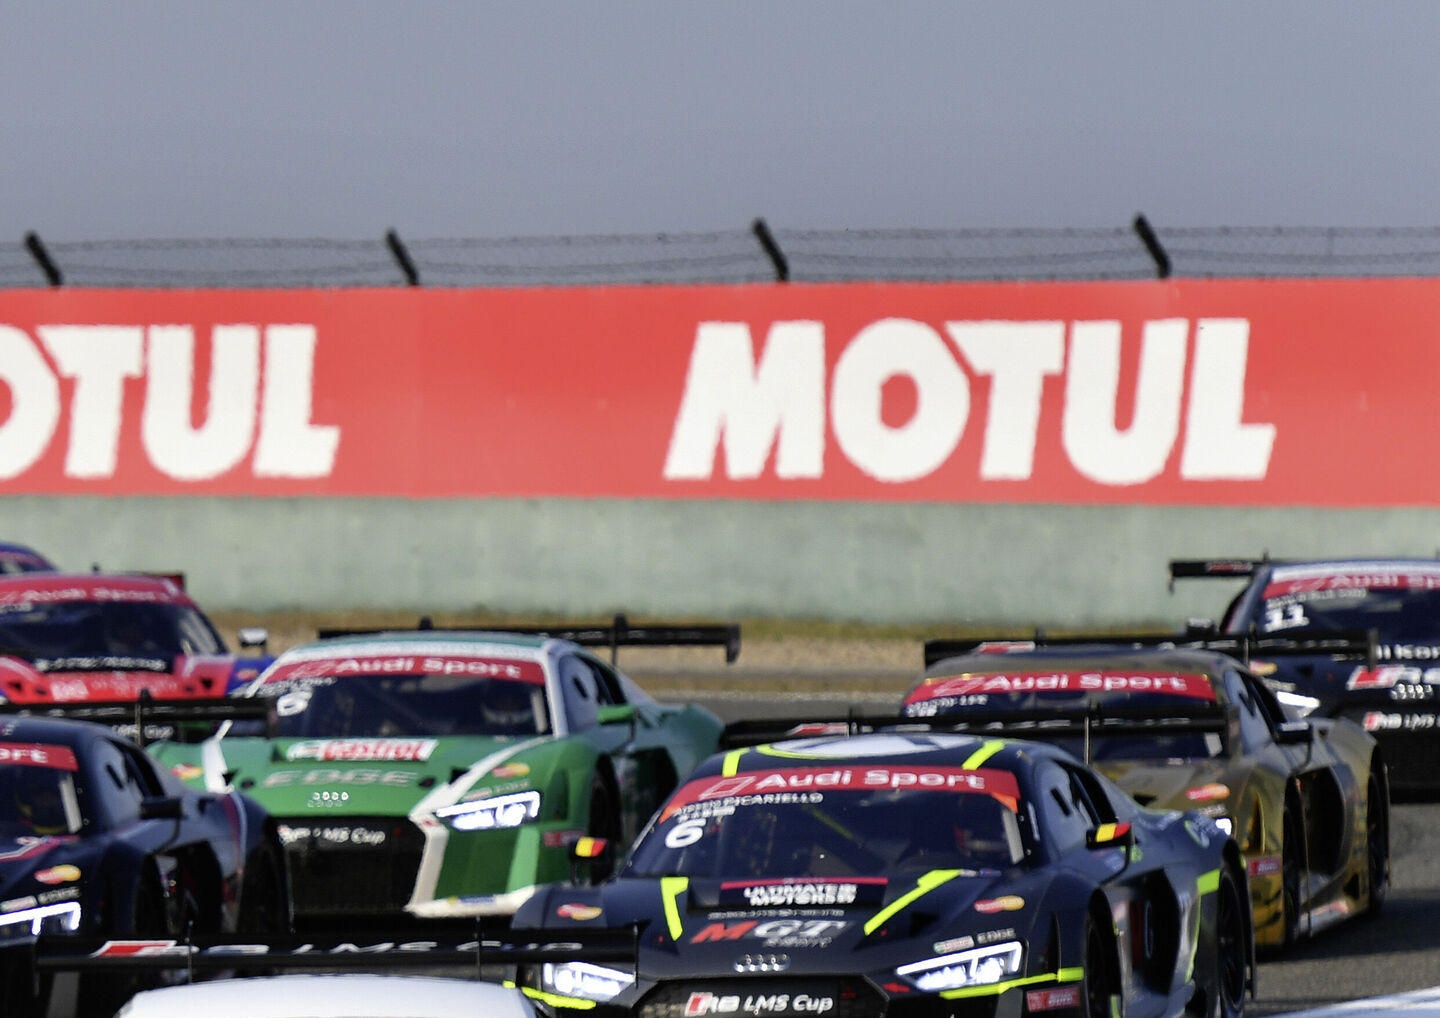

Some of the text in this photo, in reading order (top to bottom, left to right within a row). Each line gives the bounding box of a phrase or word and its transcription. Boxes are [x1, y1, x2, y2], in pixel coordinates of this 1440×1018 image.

[663, 317, 1277, 486] MOTUL
[336, 656, 522, 679] Audi Sport
[983, 673, 1188, 692] Audi Sport
[263, 768, 418, 788] EDGE
[755, 769, 986, 790] Audi Sport
[665, 818, 707, 849] 6
[743, 994, 790, 1013] LMS
[791, 994, 834, 1014] Cup
